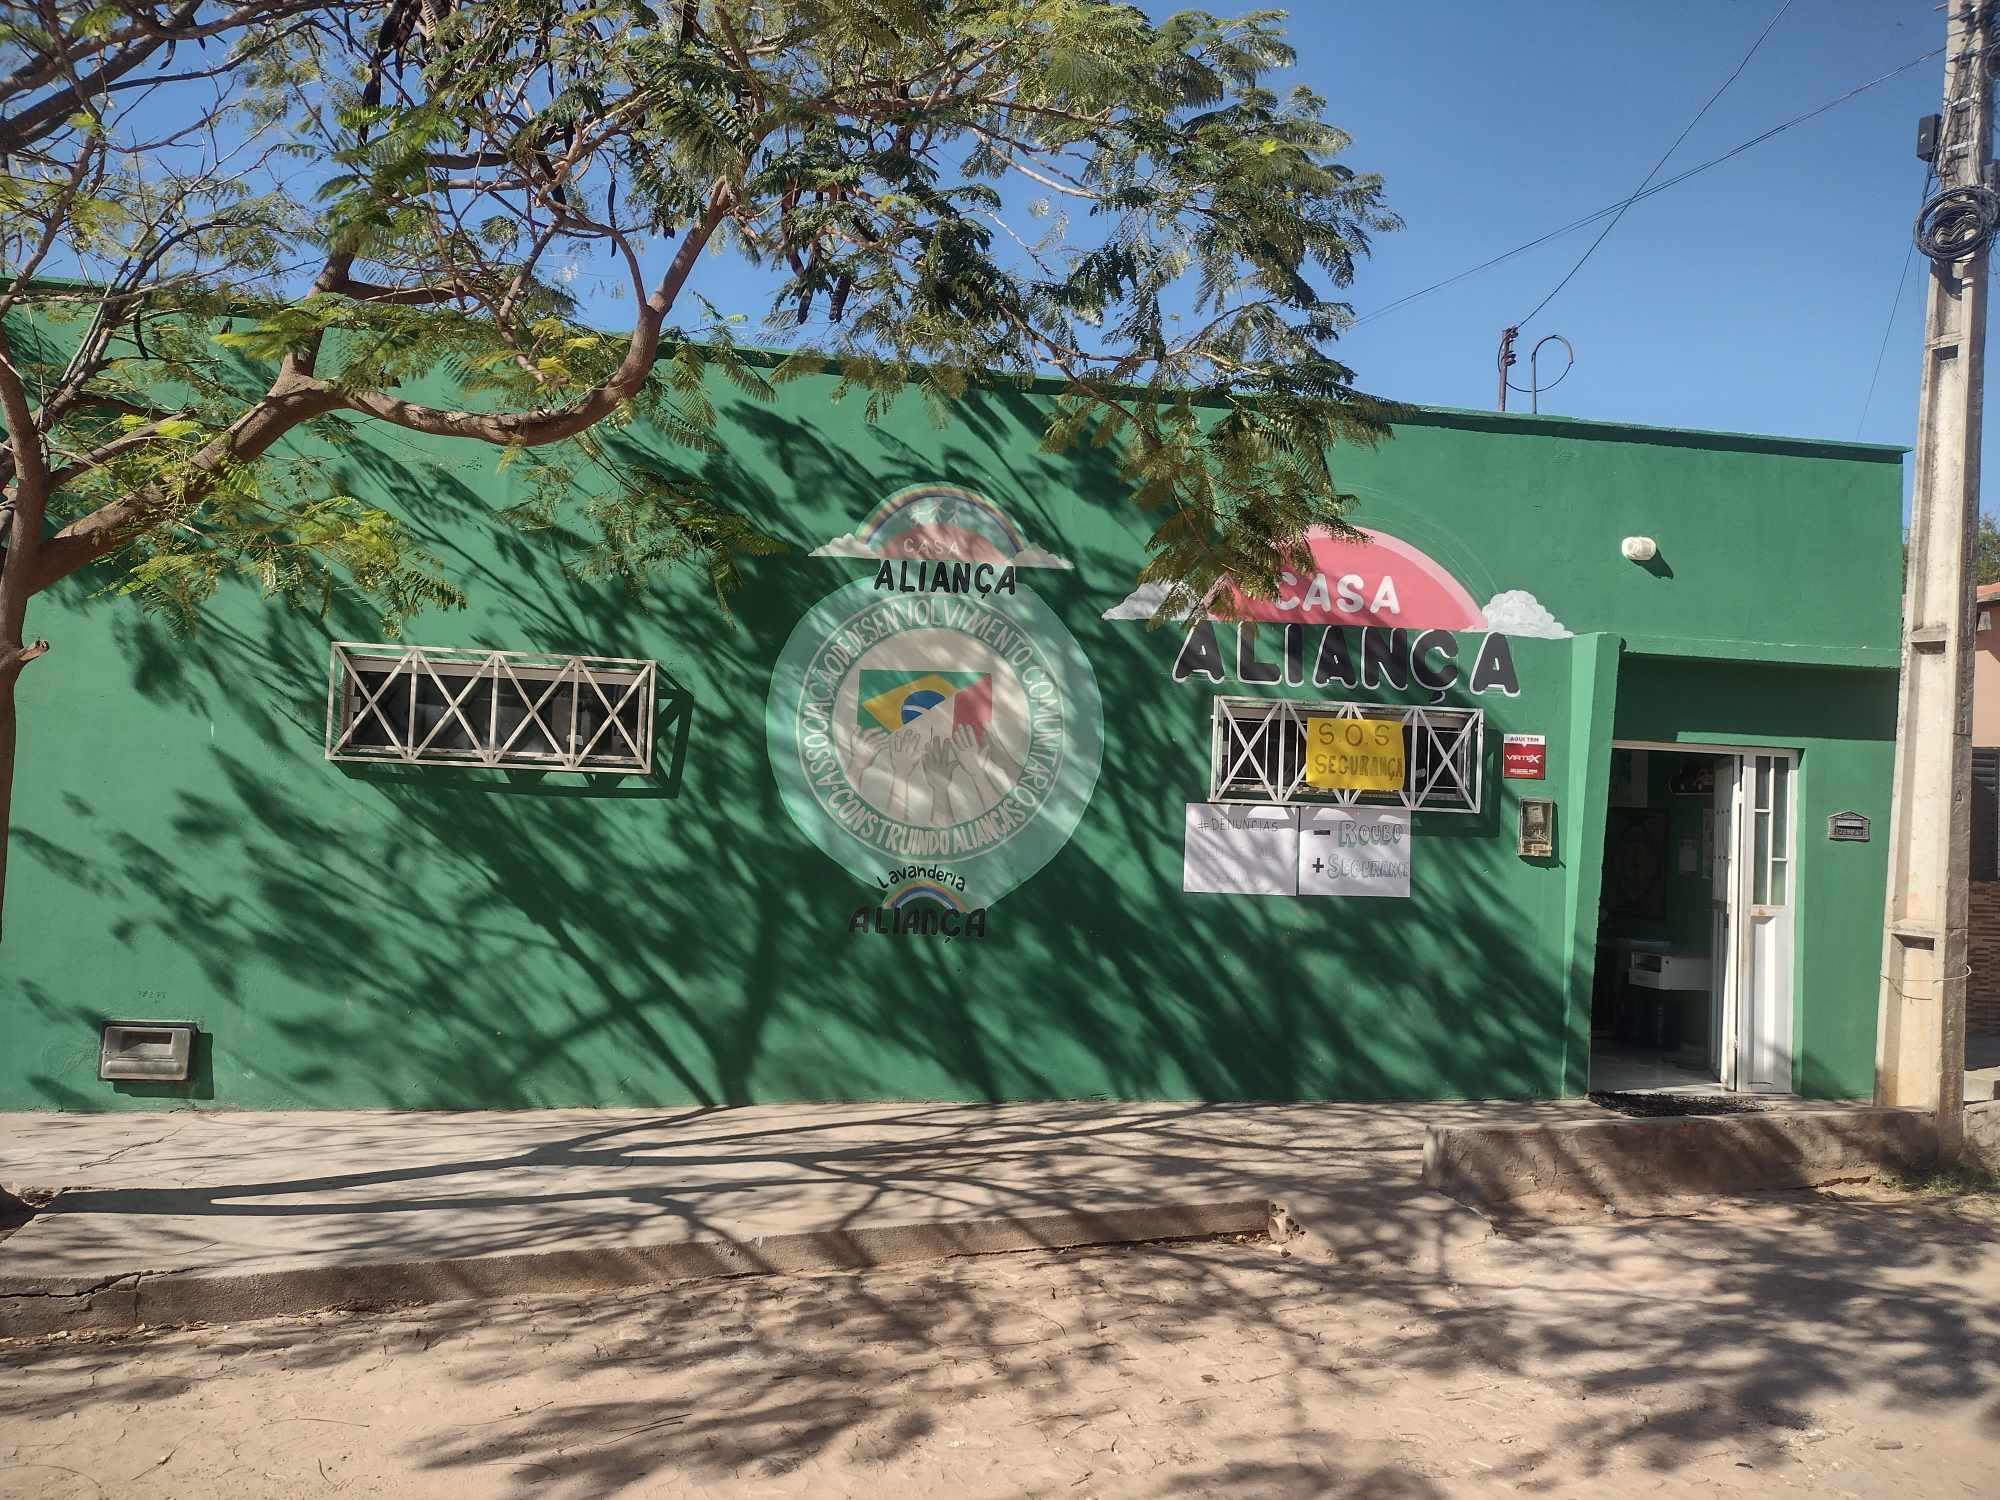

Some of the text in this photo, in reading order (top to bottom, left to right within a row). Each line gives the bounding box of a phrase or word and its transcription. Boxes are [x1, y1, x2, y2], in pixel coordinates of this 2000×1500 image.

[904, 537, 960, 554] CASA
[874, 559, 1016, 599] ALIANÇA
[1274, 571, 1401, 614] CASA
[845, 597, 1033, 667] DESENVOLVIMENTO
[1172, 620, 1521, 705] ALIANÇA
[876, 864, 967, 892] Lavanderia
[850, 905, 987, 944] ALIANÇA
